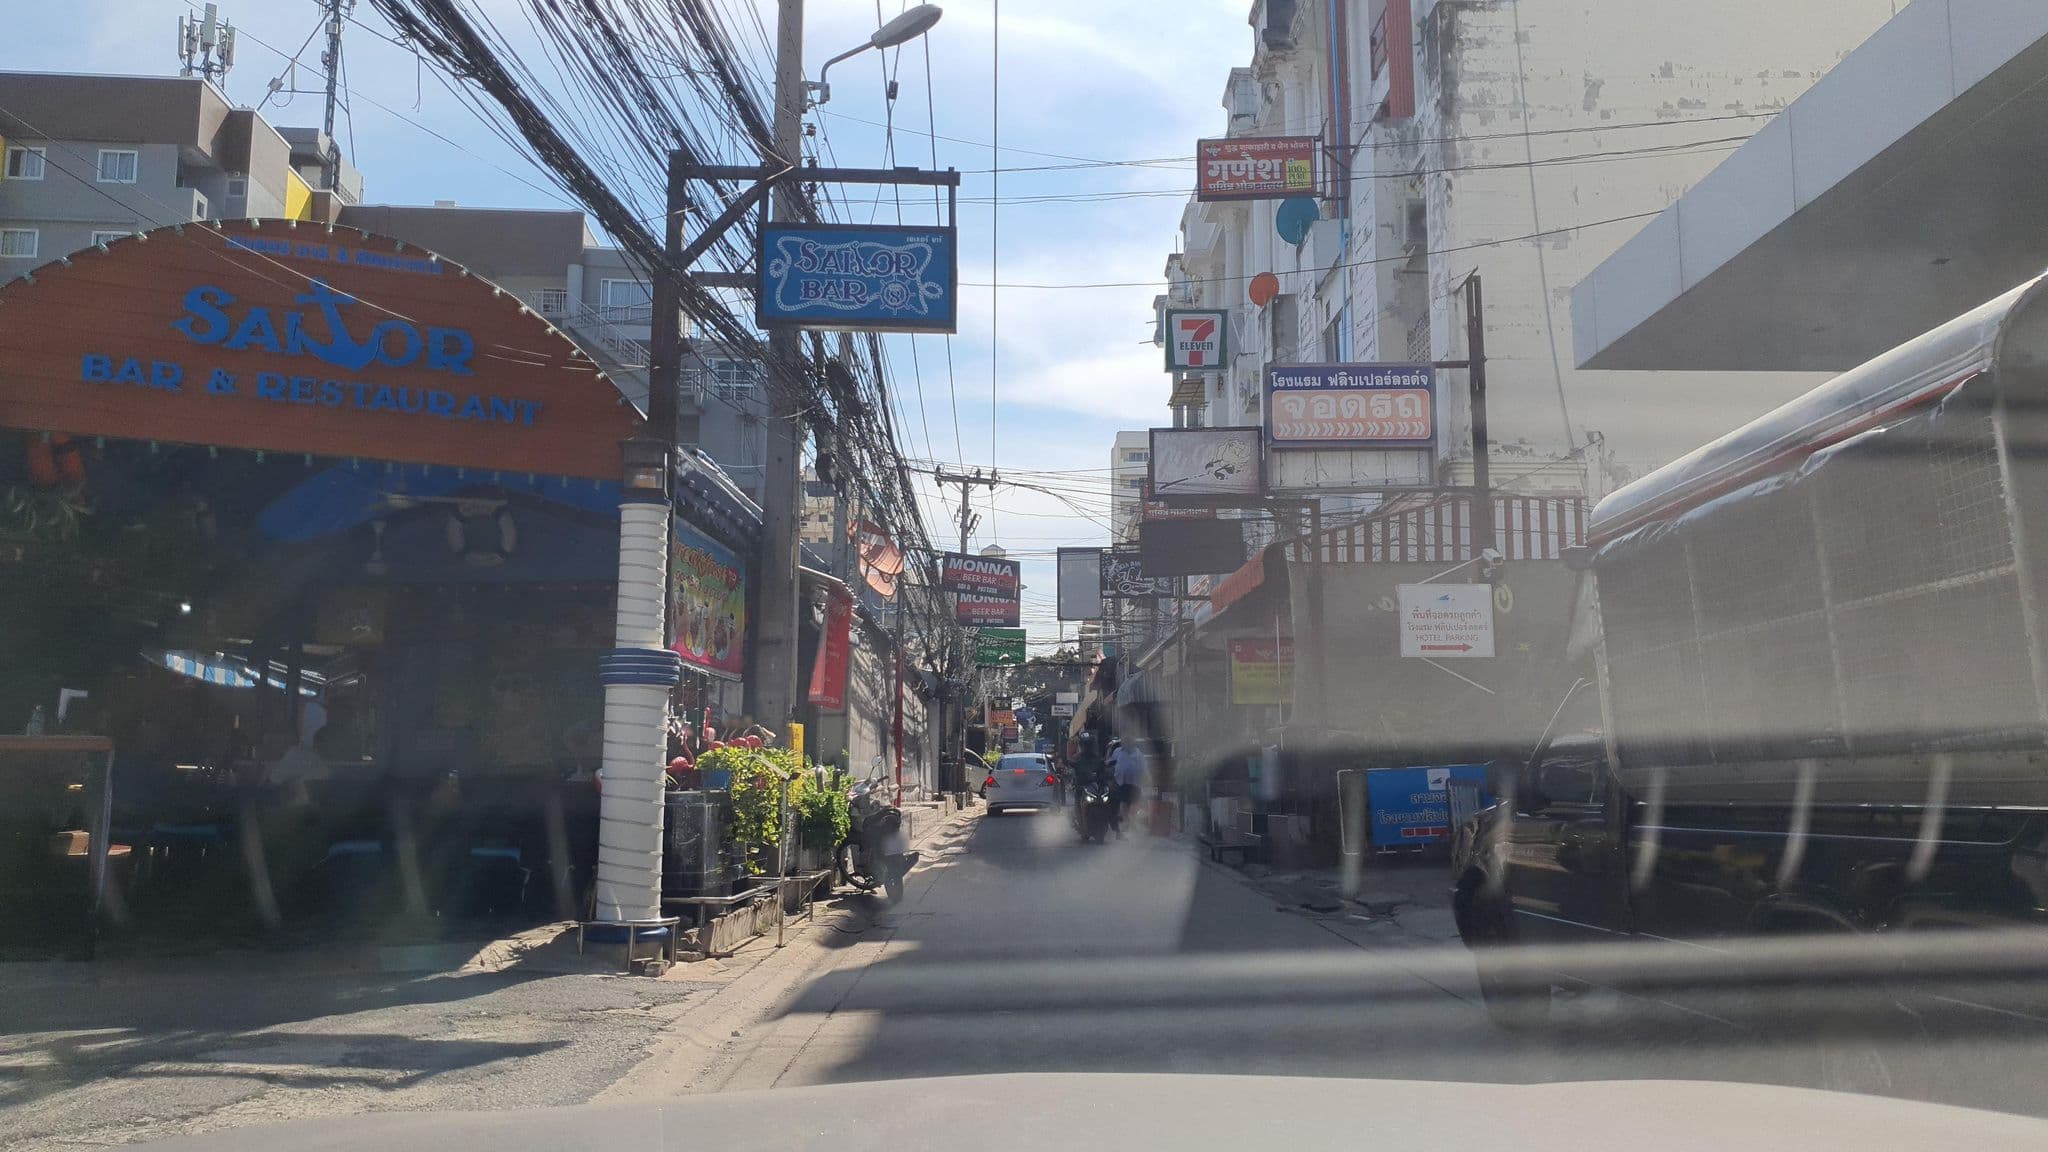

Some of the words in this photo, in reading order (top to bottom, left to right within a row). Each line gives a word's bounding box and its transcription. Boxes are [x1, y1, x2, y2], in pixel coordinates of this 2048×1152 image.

[1207, 151, 1283, 181] गणेश
[795, 240, 919, 280] SAILOR
[800, 279, 869, 305] BAR
[169, 277, 478, 377] SAILOR
[1181, 319, 1215, 366] 7
[81, 353, 184, 394] BAR
[207, 367, 239, 395] &
[256, 370, 543, 427] RESTAURANT
[1270, 371, 1321, 387] โรงแรม
[1280, 393, 1423, 419] จอดรถ
[948, 557, 1013, 577] MONNA
[962, 573, 981, 583] BEER
[982, 575, 997, 585] BAR
